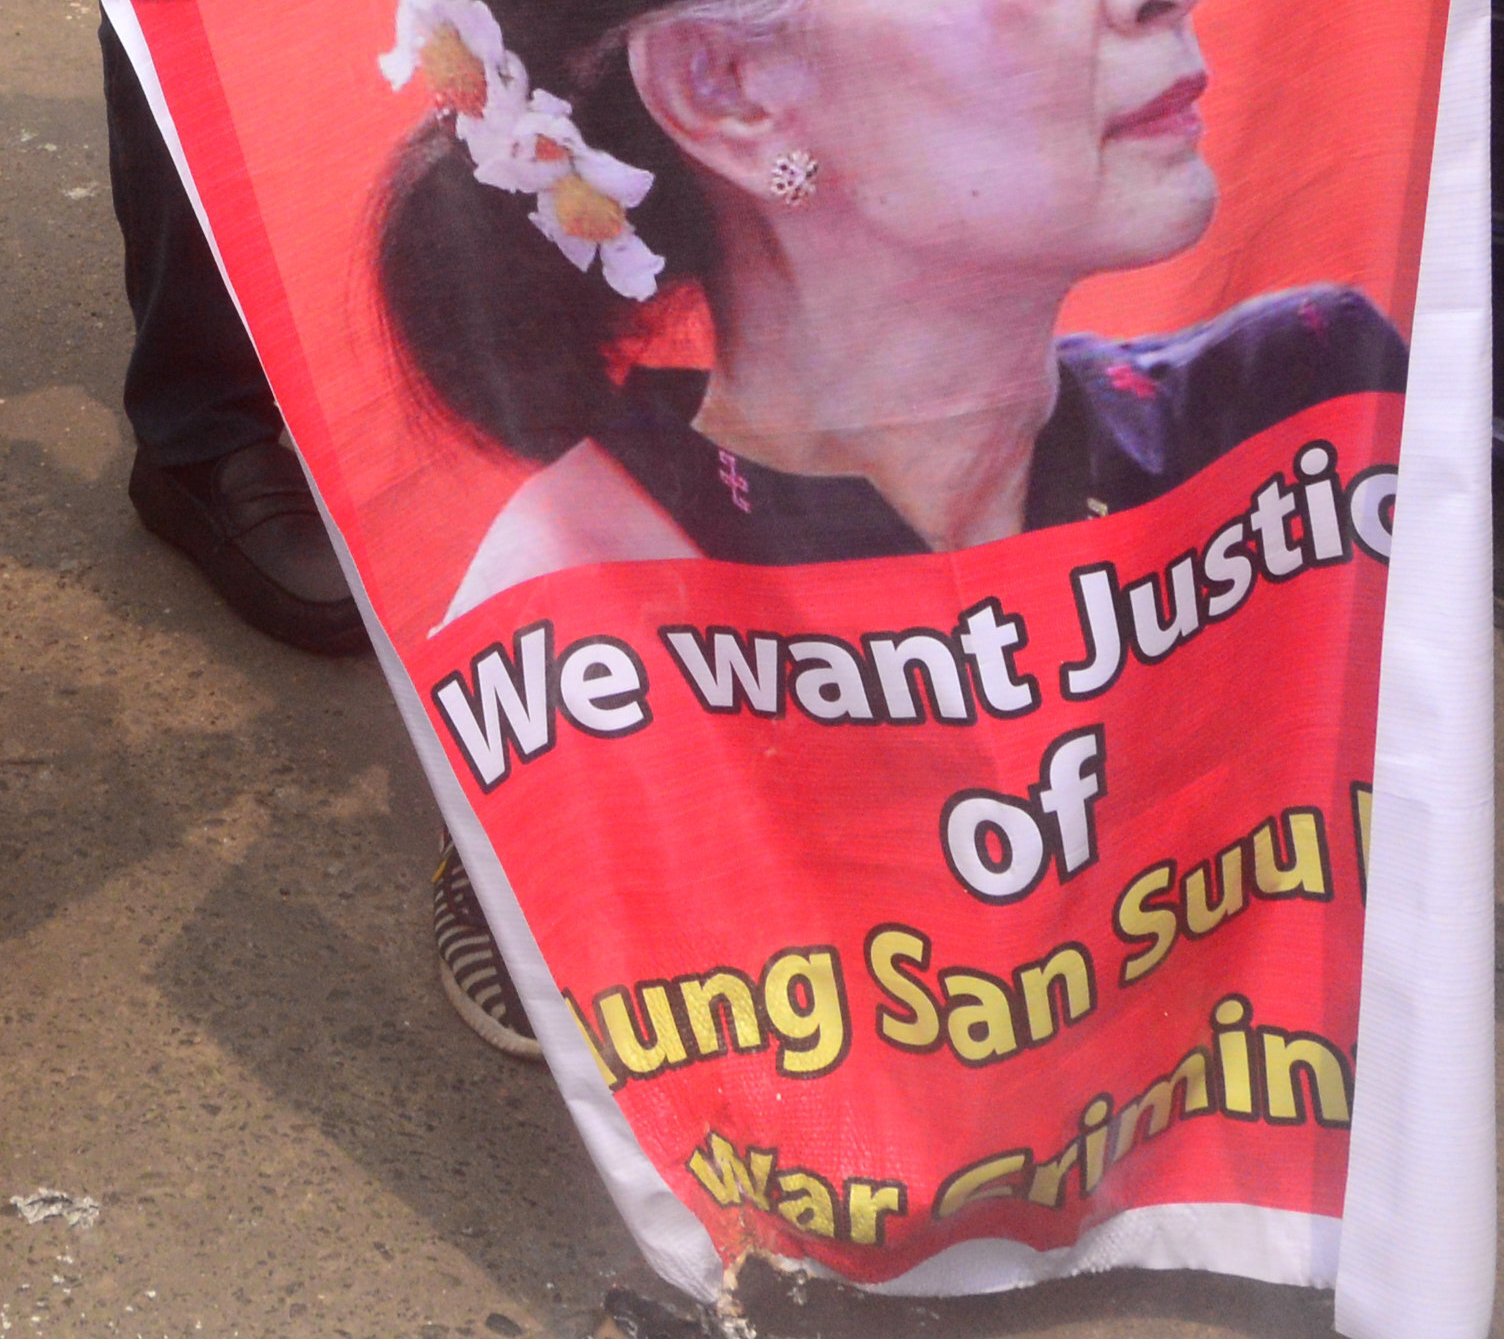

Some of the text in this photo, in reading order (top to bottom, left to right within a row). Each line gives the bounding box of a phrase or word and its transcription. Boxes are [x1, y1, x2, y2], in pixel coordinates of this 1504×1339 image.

[433, 619, 650, 794] We
[664, 597, 1041, 724] want
[943, 727, 1106, 905] of
[565, 947, 851, 1091] ung
[865, 923, 1096, 1069] San
[1113, 807, 1333, 988] Suu
[686, 994, 1356, 1246] War Crimin
